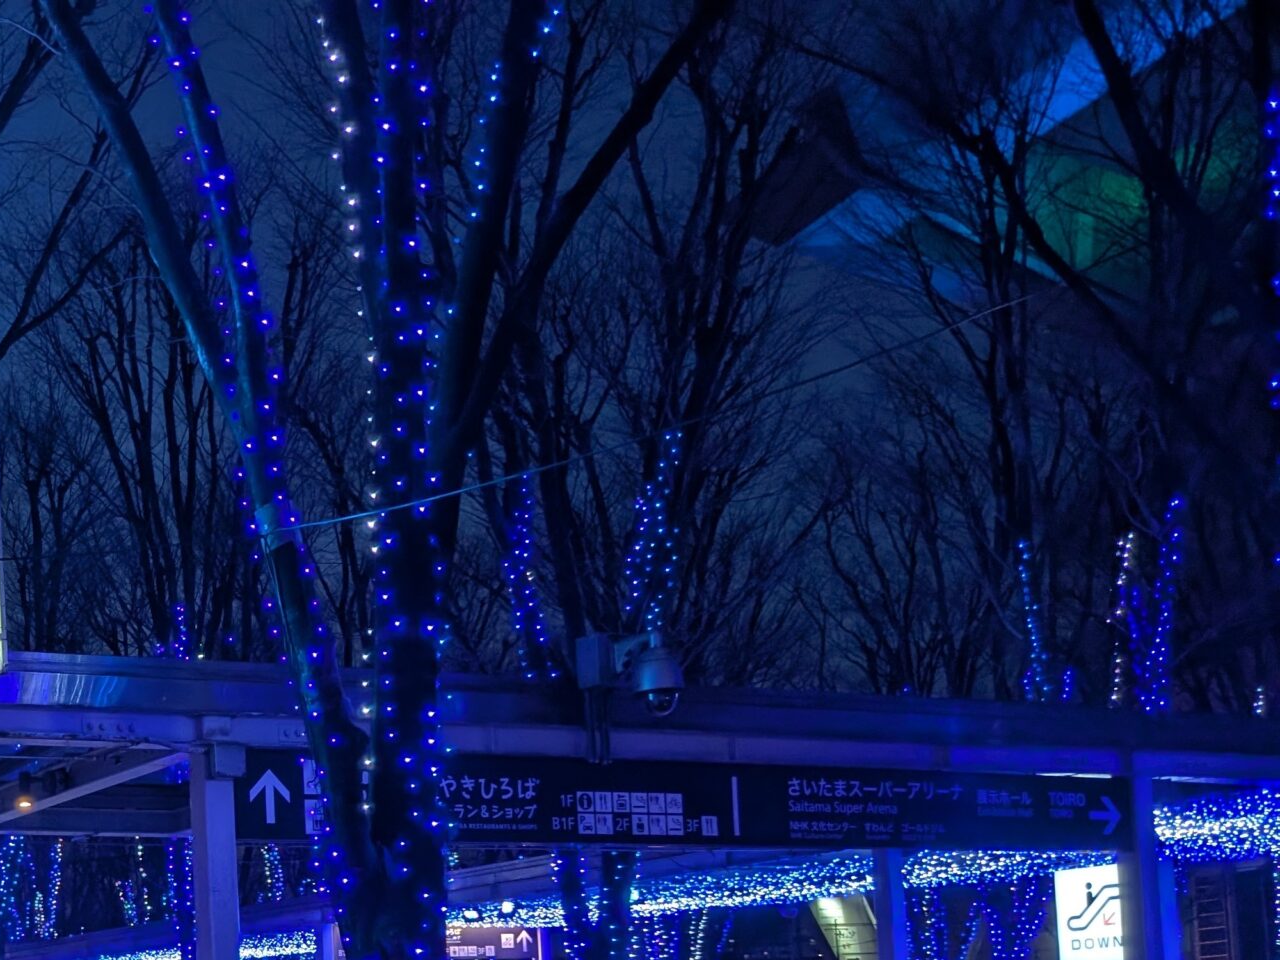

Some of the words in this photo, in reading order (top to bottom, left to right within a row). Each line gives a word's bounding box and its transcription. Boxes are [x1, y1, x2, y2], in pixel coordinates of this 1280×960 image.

[787, 777, 964, 801] さいたまスーパーアリーナ
[560, 794, 574, 808] 1F
[1048, 792, 1086, 807] TOIRO
[787, 800, 832, 814] Saitama
[833, 802, 864, 817] Super
[865, 802, 899, 815] Arena
[552, 817, 576, 831] B1F
[615, 818, 630, 832] 2F
[685, 818, 700, 832] 3F
[1071, 935, 1124, 950] DOWN
